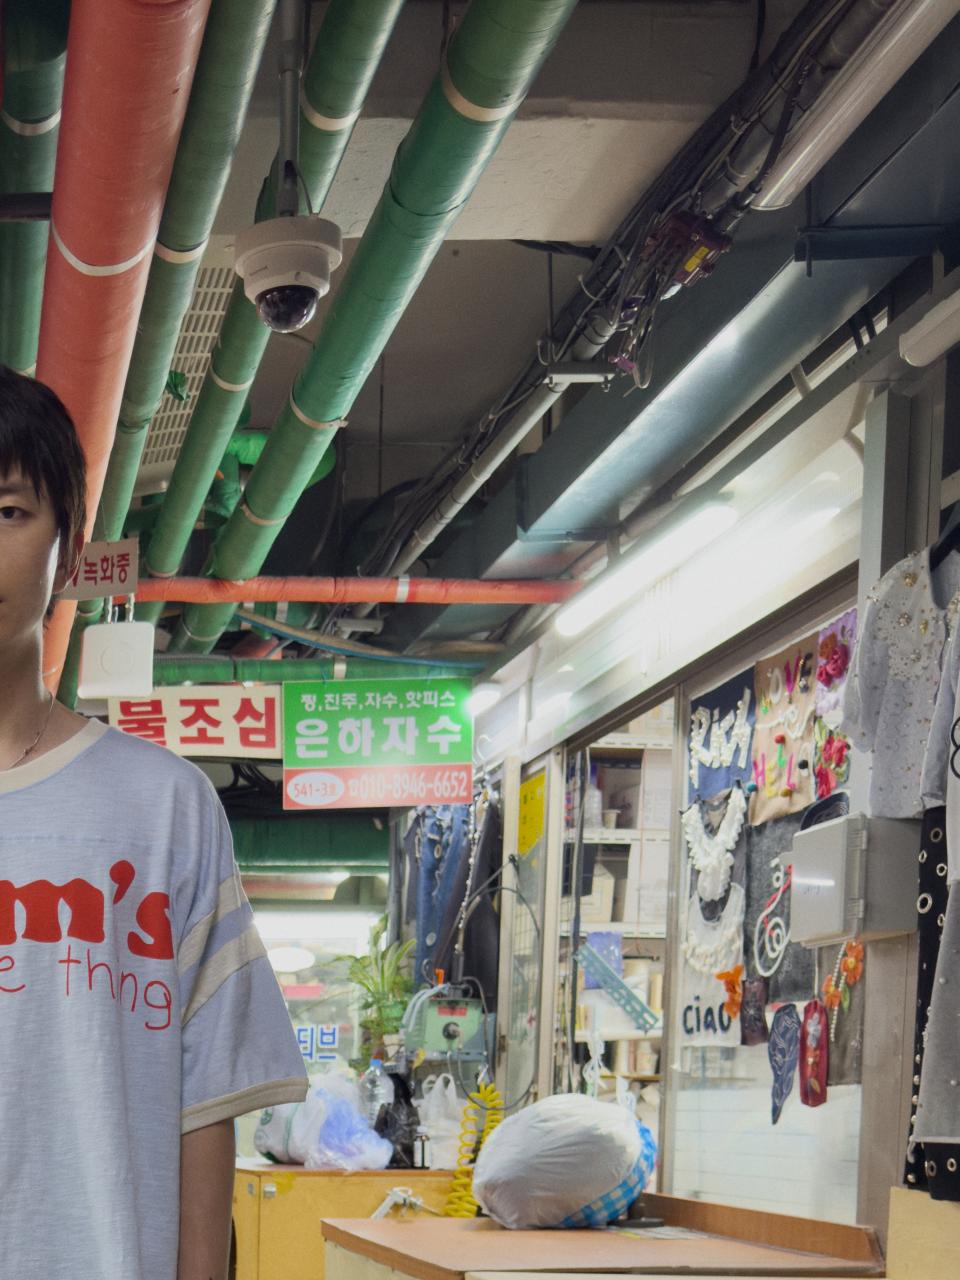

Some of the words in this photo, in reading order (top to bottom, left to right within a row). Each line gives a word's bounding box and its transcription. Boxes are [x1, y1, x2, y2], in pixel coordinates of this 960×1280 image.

[84, 553, 130, 586] 녹화중
[117, 697, 276, 749] 불조심
[294, 714, 462, 759] 은하자수
